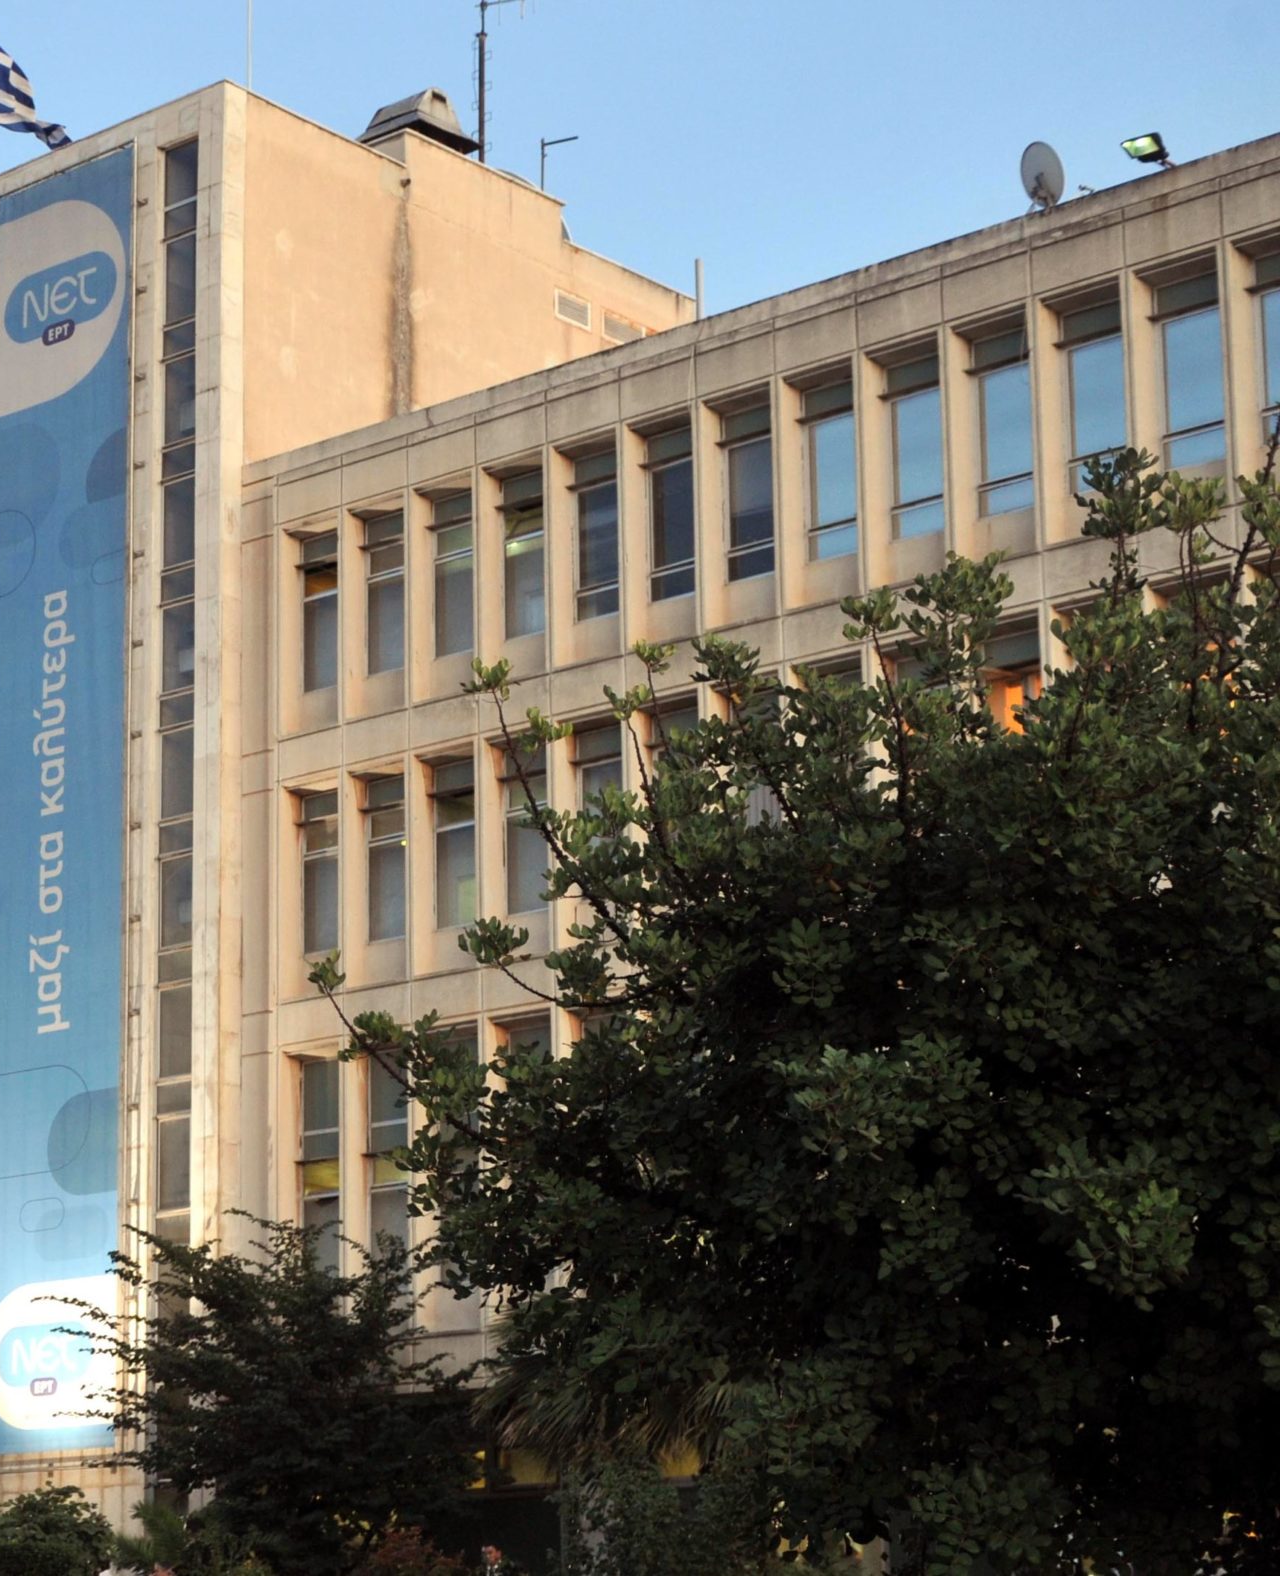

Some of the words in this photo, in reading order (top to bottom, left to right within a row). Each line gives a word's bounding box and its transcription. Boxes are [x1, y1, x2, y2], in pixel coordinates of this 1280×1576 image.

[47, 322, 71, 342] ΕΡΤ
[32, 589, 75, 817] καλύτερα
[38, 831, 64, 915] στα
[29, 929, 70, 1035] μαζί
